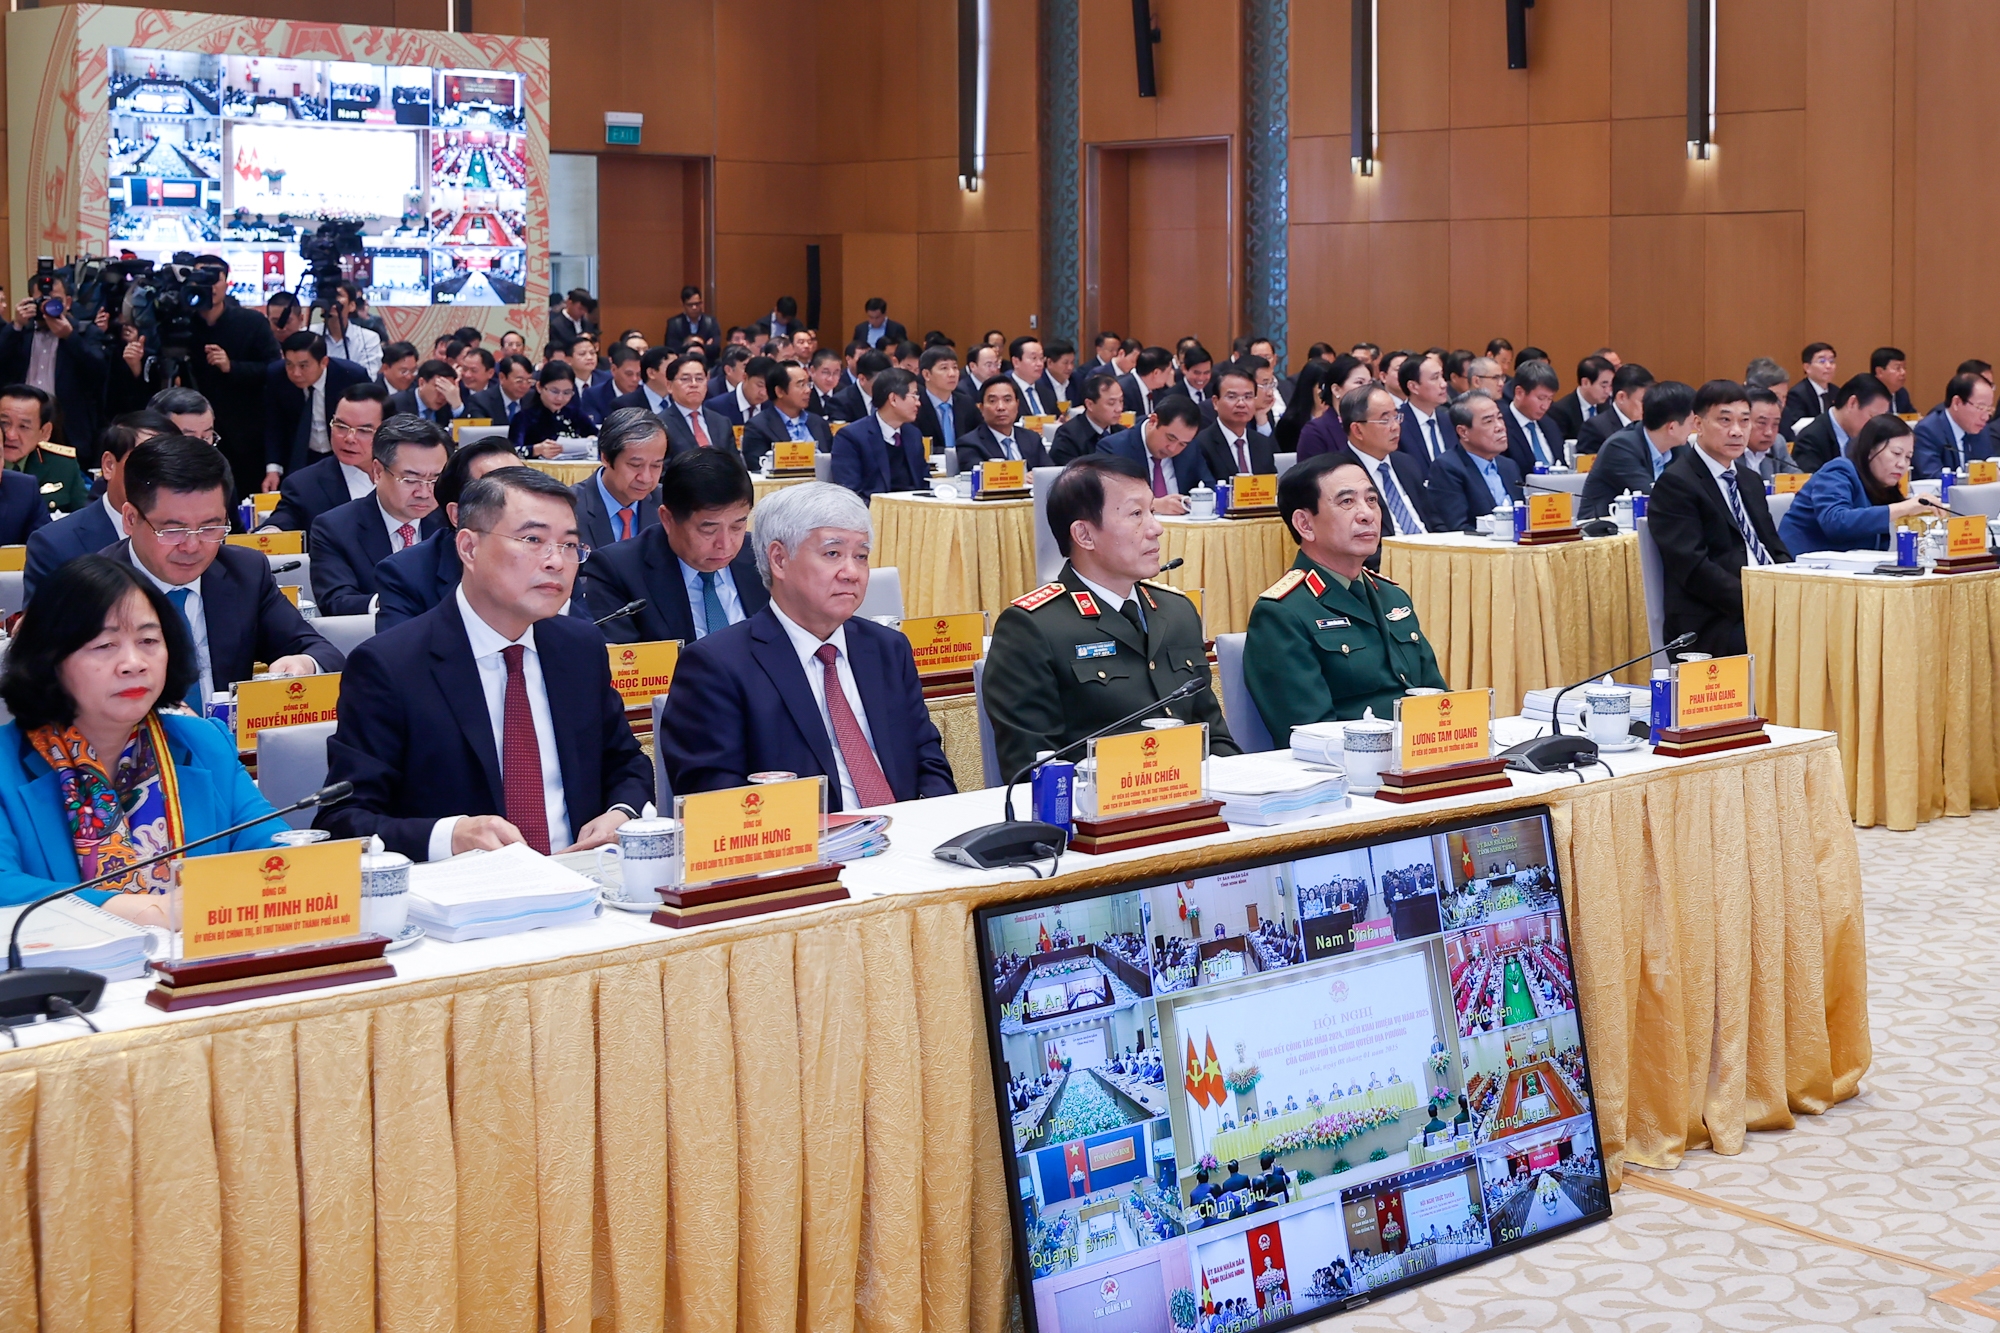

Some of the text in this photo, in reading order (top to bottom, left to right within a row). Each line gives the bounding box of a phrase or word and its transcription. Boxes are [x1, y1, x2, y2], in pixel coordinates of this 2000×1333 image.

[338, 108, 359, 120] Nam
[642, 676, 668, 686] DUNG
[1690, 689, 1735, 704] PHAN VĂN GIANG
[247, 712, 288, 729] NGUYỄN
[291, 710, 318, 724] HỒNG
[1413, 727, 1477, 746] LƯƠNG TAM QUANG
[1121, 765, 1180, 789] ĐỖ VĂN CHIẾN
[713, 827, 791, 853] LÊ MINH HƯNG
[208, 892, 338, 925] BÙI THỊ MINH HOÀI
[1315, 933, 1345, 950] Nam
[1347, 924, 1375, 943] Dinh
[1166, 962, 1198, 982] Ninh
[1000, 994, 1063, 1021] Nghe An
[1313, 1006, 1373, 1030] HỘI NGHỊ
[1468, 1011, 1489, 1026] Phu
[1016, 1117, 1075, 1143] Phu Tho
[1484, 1114, 1519, 1133] Quang
[1198, 1189, 1265, 1218] Chinh phu
[1500, 1225, 1522, 1242] Son
[1032, 1232, 1118, 1268] Quang Binh
[1366, 1255, 1423, 1289] Quang Tri
[1262, 1301, 1294, 1322] Ninh
